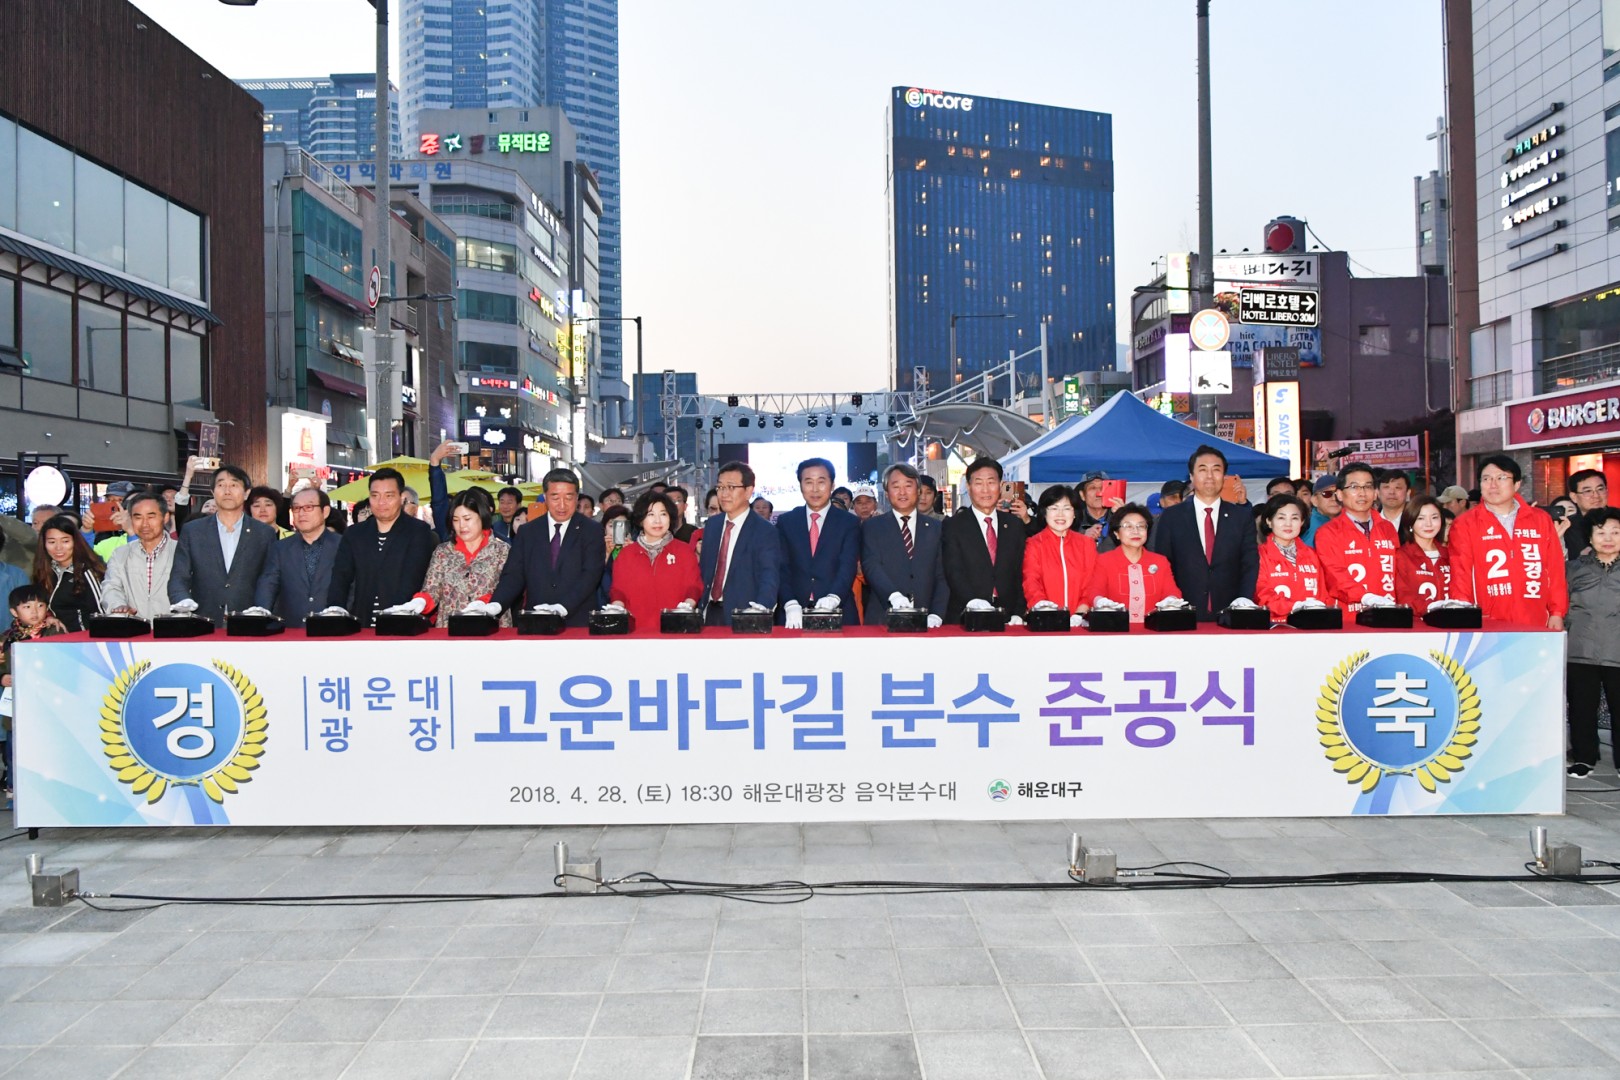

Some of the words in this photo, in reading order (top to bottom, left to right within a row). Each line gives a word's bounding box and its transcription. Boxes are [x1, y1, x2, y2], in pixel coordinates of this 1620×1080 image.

[905, 88, 974, 112] encore
[498, 133, 551, 153] 뮤직타운
[1242, 292, 1301, 312] 리베로호텔
[1242, 311, 1269, 321] HOTEL
[1270, 312, 1299, 322] LIBERO
[1299, 314, 1315, 323] 30M
[1239, 331, 1255, 340] hite
[1290, 333, 1314, 342] EXTRA
[1266, 352, 1297, 360] LIBERO
[1266, 360, 1296, 368] HOTEL
[1266, 369, 1298, 377] 리베로호텔
[1548, 397, 1620, 430] BURGER
[1278, 414, 1290, 446] SAVE
[1362, 438, 1411, 452] 토리헤어
[1514, 528, 1537, 539] 구의원
[1485, 548, 1510, 580] 2
[1520, 543, 1542, 599] 김경호
[318, 676, 440, 712] 해운대
[474, 672, 847, 751] 고운바다길
[871, 672, 1021, 749] 분수
[1038, 667, 1255, 749] 준공식
[1366, 671, 1436, 748] 축
[152, 682, 215, 759] 경
[509, 786, 561, 805] 2018.
[570, 786, 589, 804] 4.
[597, 785, 628, 805] 28.
[636, 783, 673, 806] (토)
[681, 784, 734, 803] 18:30
[742, 782, 847, 805] 해운대광장
[854, 780, 958, 803] 음악분수대
[1017, 781, 1084, 800] 해운대구
